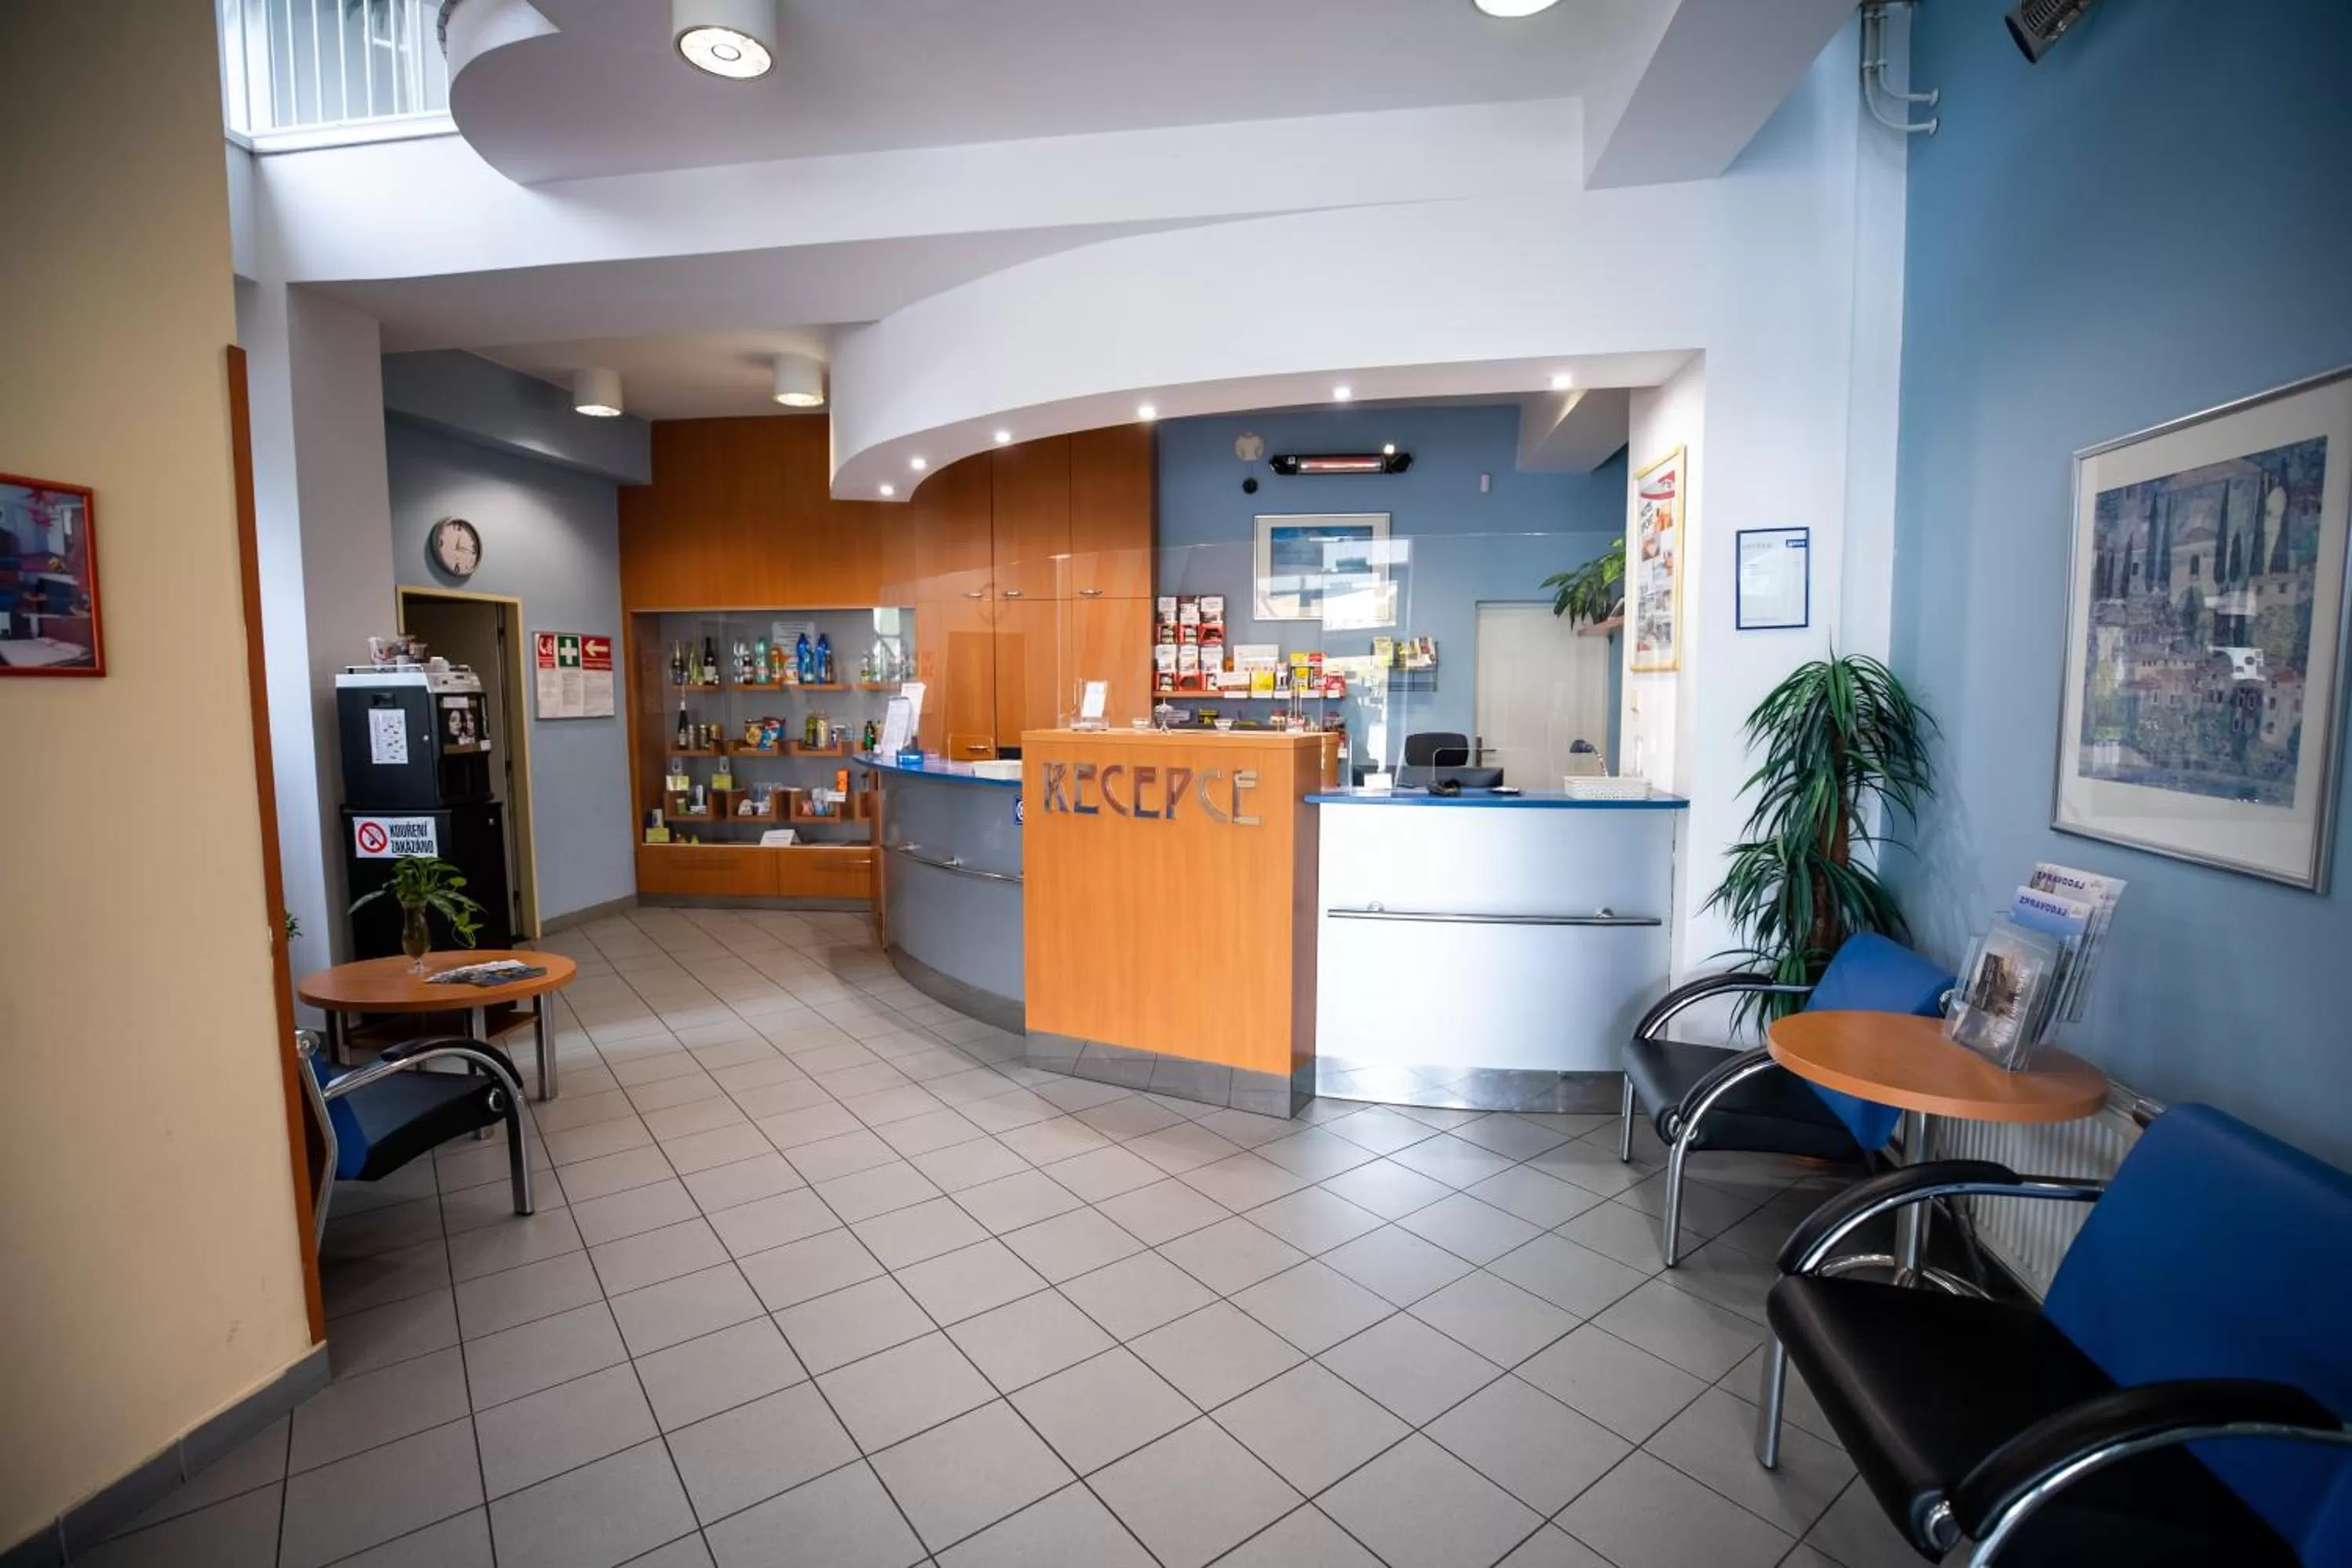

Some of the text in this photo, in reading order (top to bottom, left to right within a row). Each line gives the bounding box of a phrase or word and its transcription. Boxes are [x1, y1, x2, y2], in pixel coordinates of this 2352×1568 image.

[1041, 762, 1261, 826] RECEPCE
[389, 820, 427, 837] KOUŘENÍ
[2037, 871, 2085, 890] ZPRAVODAJ
[2020, 895, 2067, 916] ZPRAVODAJ
